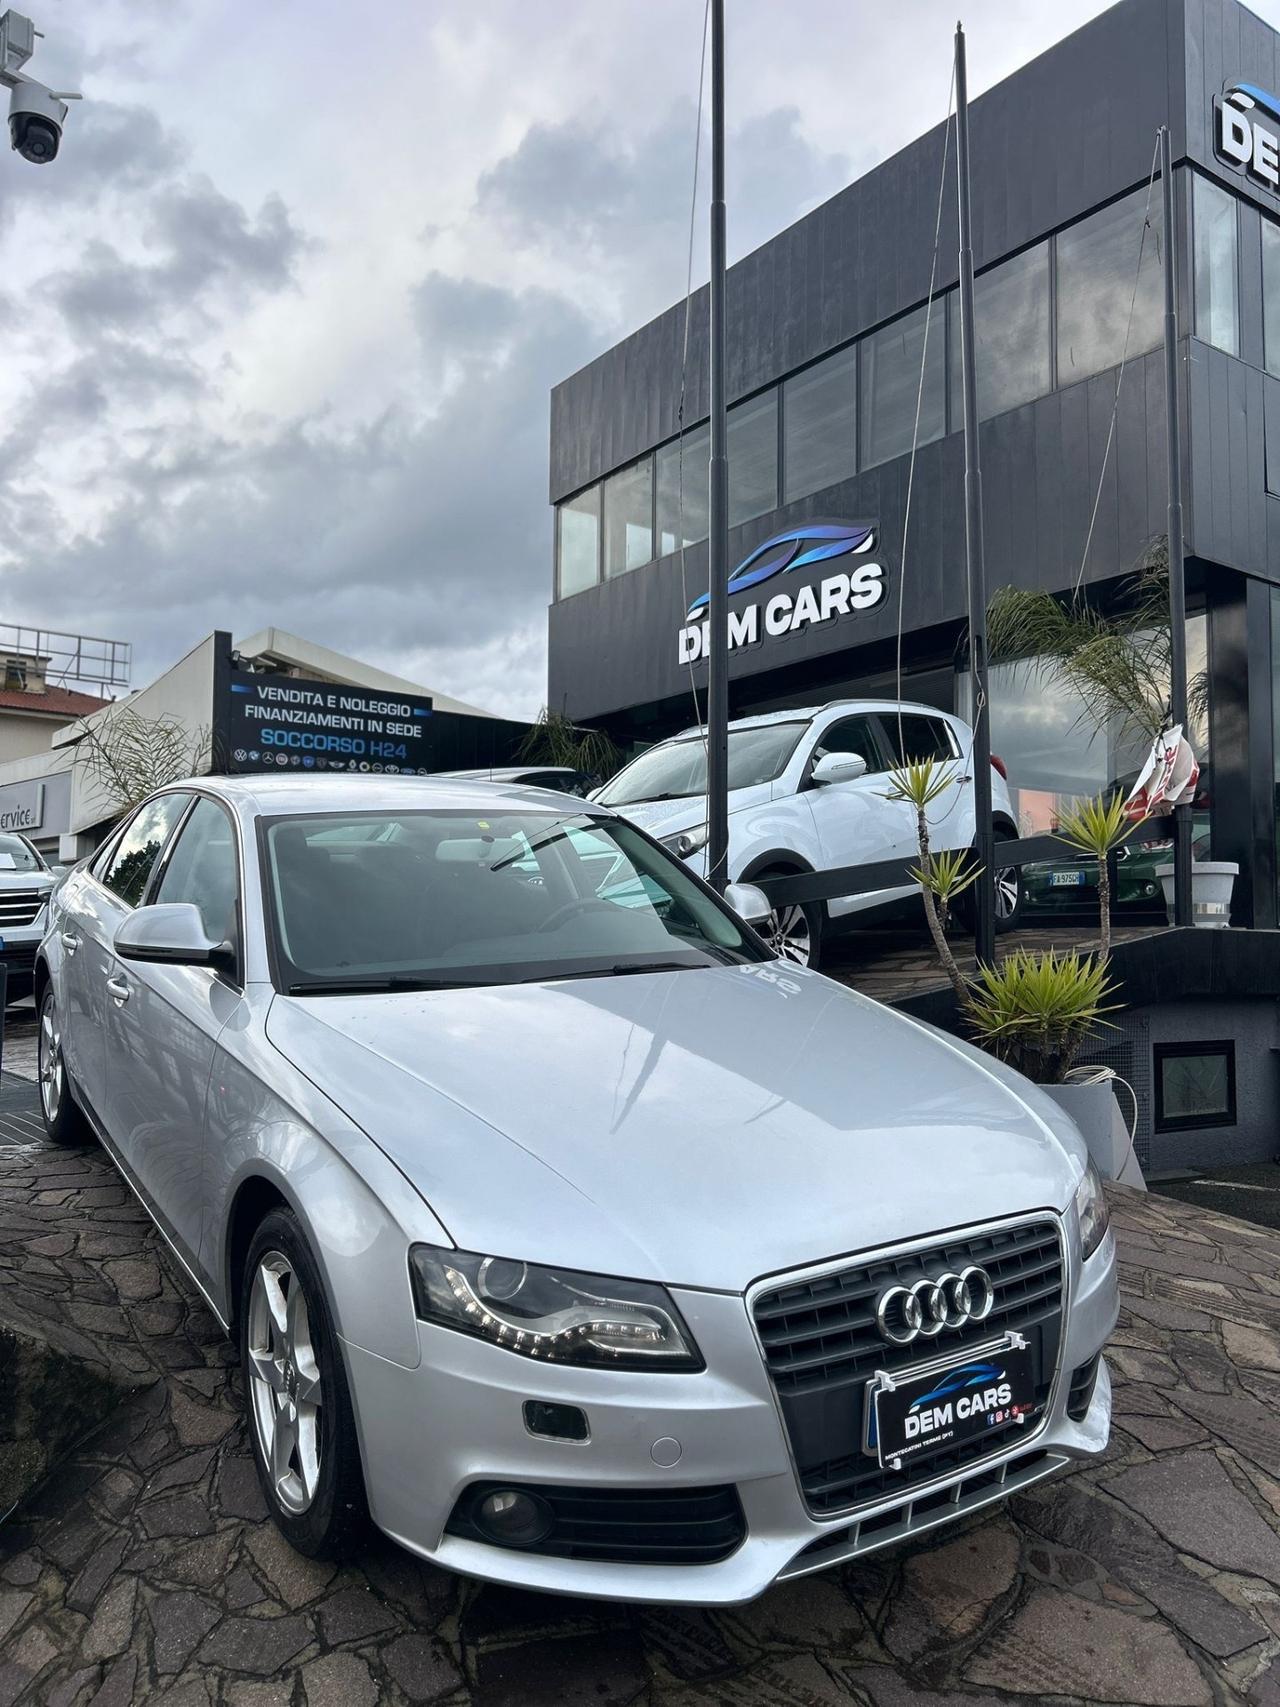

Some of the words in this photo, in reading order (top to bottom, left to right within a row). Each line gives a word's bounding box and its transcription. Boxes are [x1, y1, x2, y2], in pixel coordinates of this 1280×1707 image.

[1222, 102, 1278, 184] DE
[678, 604, 757, 665] DM
[765, 562, 883, 636] CARS
[256, 685, 324, 706] VENDITA
[327, 695, 336, 706] E
[340, 696, 411, 718] NOLEGGIO
[245, 705, 364, 731] FINANZIAMENTI
[367, 720, 383, 734] IN
[386, 723, 422, 738] SEDE
[261, 728, 365, 754] SOCCORSO
[370, 740, 408, 759] H24
[904, 1402, 953, 1439] DEM
[956, 1383, 1012, 1420] CARS
[885, 1442, 922, 1460] MONTECATINI
